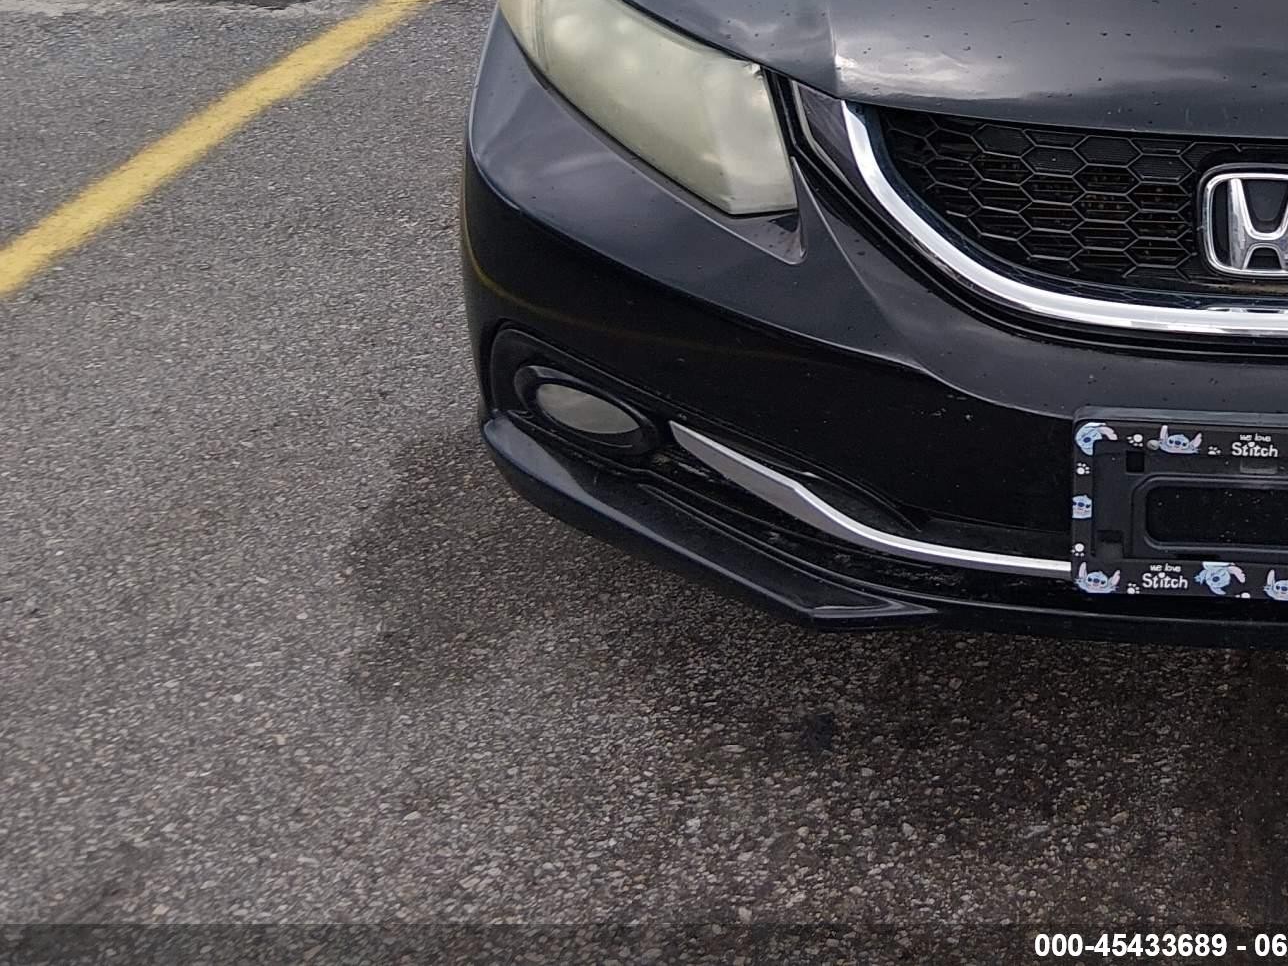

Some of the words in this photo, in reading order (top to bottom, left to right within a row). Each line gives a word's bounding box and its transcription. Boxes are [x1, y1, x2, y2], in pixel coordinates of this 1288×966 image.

[1239, 434, 1252, 442] we
[1254, 433, 1272, 442] love
[1231, 441, 1279, 458] Stitch
[1149, 564, 1163, 572] we
[1164, 564, 1181, 573] love
[1142, 572, 1188, 589] Stitch
